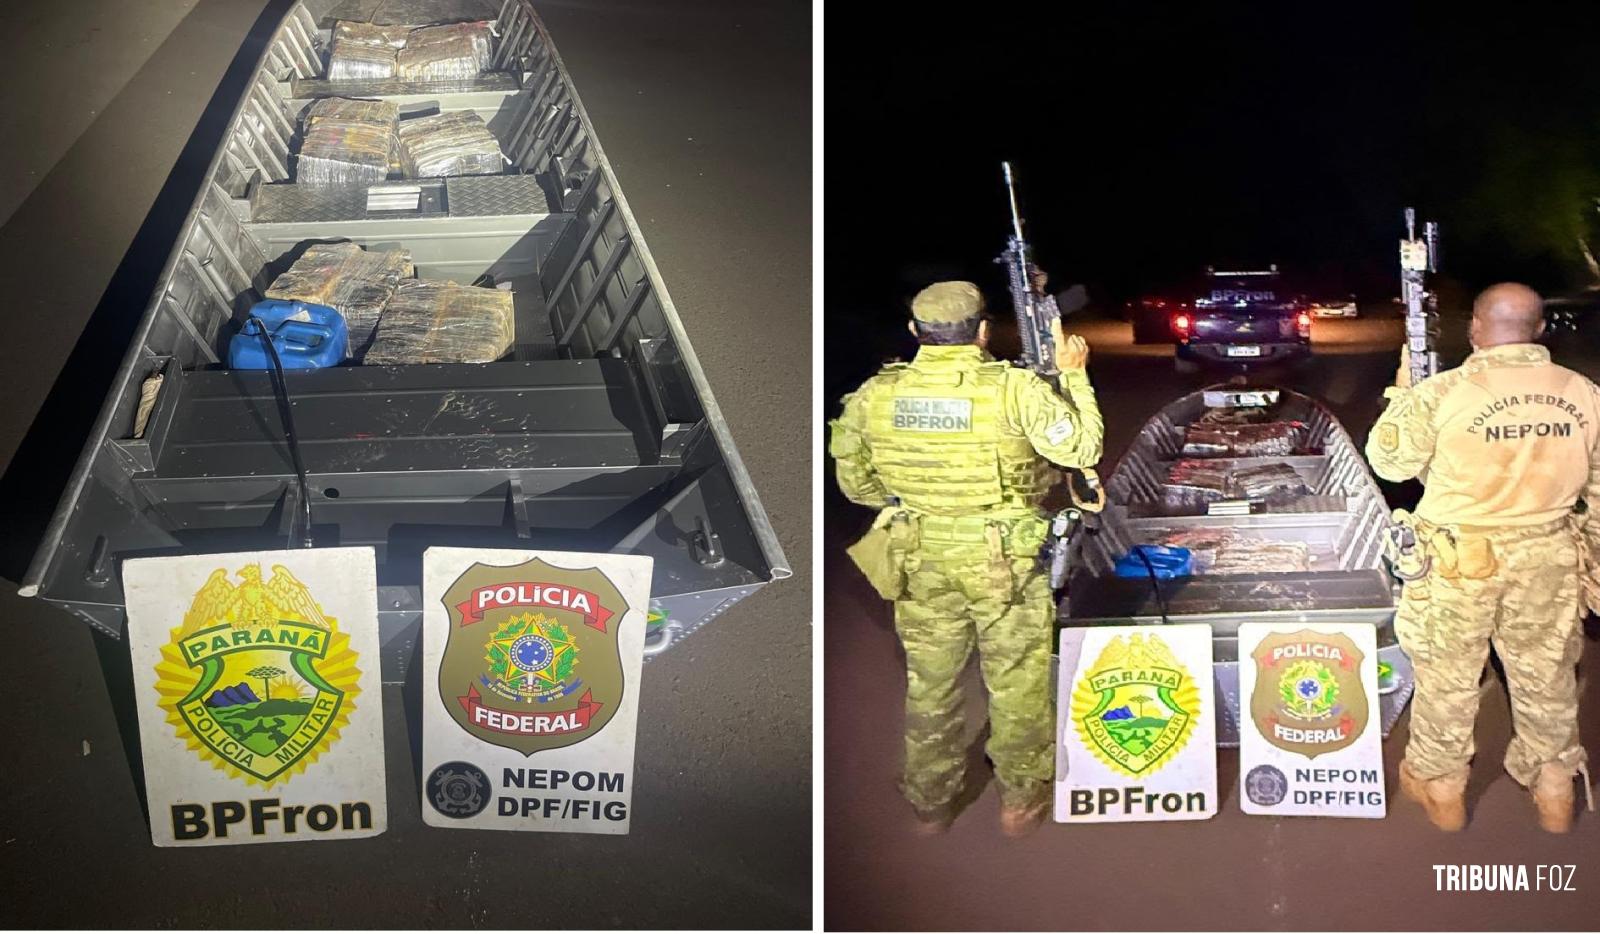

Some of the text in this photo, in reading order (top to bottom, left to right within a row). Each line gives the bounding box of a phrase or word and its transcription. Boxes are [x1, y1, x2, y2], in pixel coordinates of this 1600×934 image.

[894, 415, 969, 430] BPFRON
[1525, 394, 1589, 429] FEDERAL
[1485, 422, 1571, 443] NEPOM
[478, 585, 592, 614] POLÍCIA
[189, 628, 321, 659] PARANÁ
[1094, 671, 1179, 690] PARANÁ
[188, 697, 335, 768] POLÍCIA MILITAR
[475, 706, 583, 733] FEDERAL
[1144, 715, 1184, 763] MILITAR
[1274, 726, 1345, 742] FEDERAL
[503, 767, 625, 793] NEPOM
[1295, 768, 1378, 784] NEPOM
[498, 796, 627, 821] DPF/FIG
[1069, 786, 1207, 816] BPFron
[1294, 789, 1383, 807] DPF/FIG
[171, 798, 373, 841] BPFron
